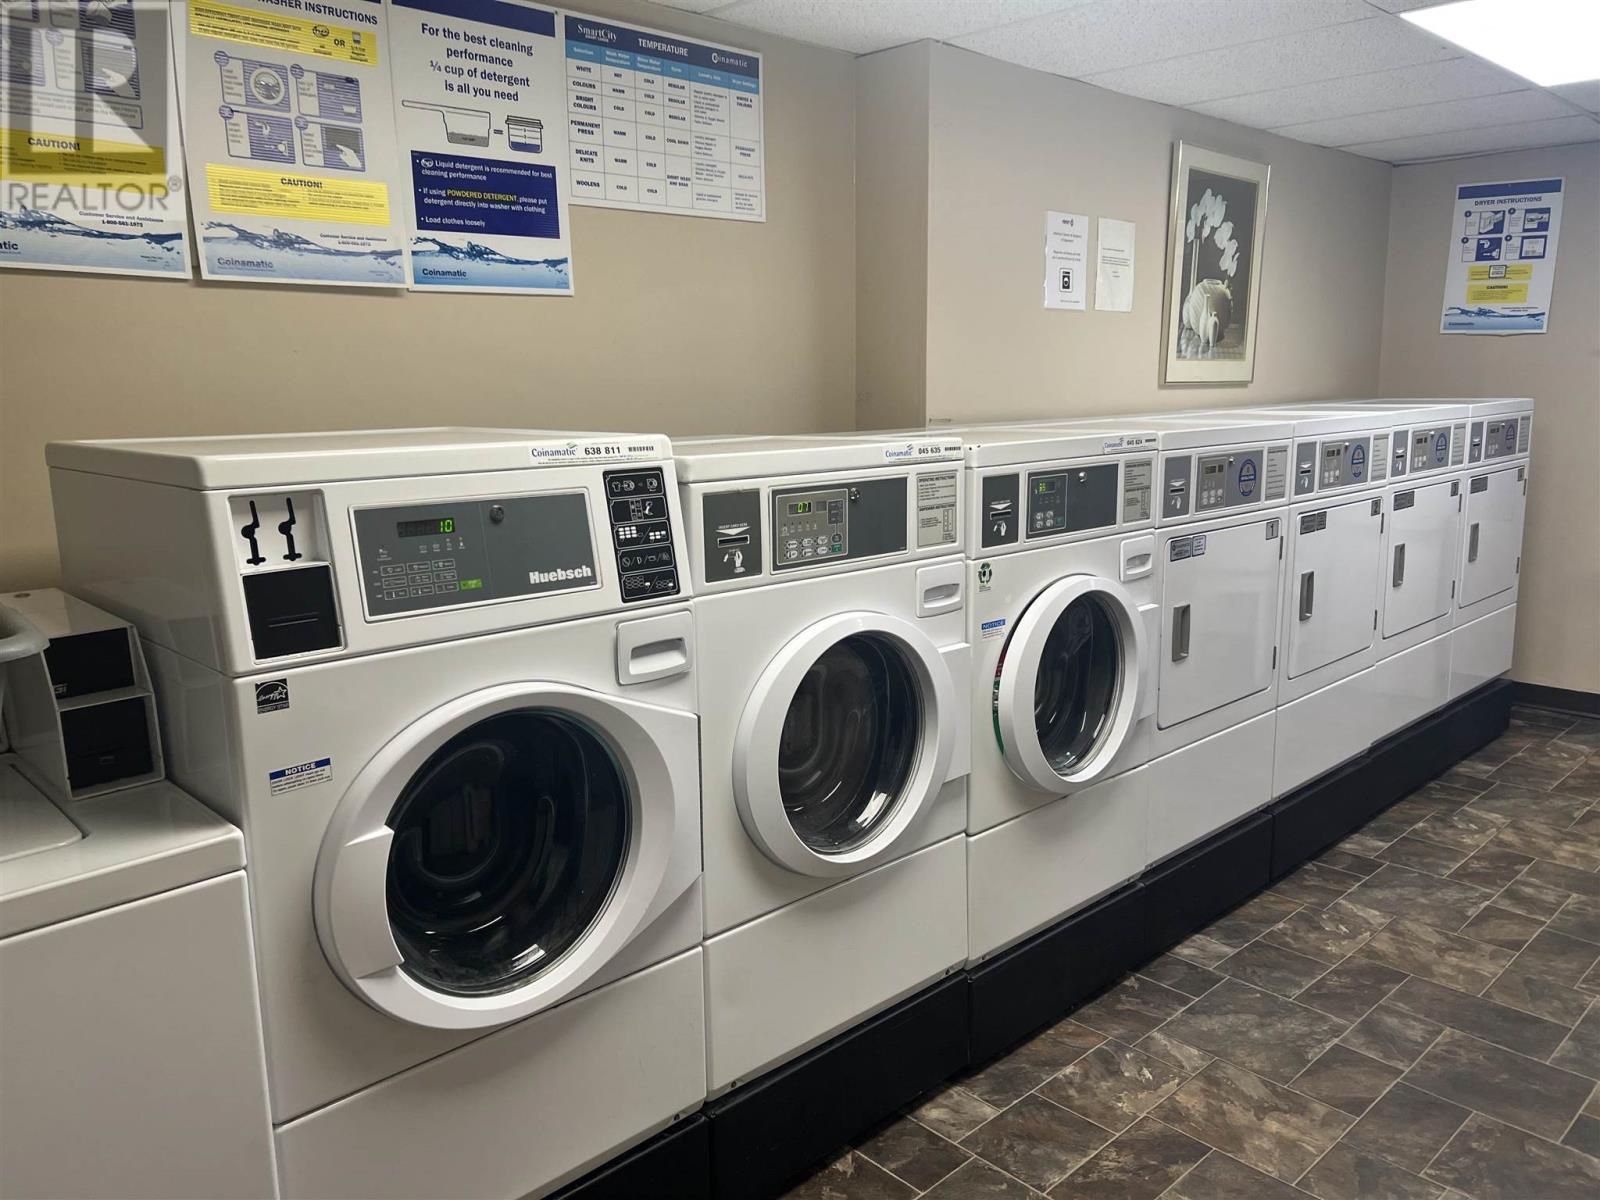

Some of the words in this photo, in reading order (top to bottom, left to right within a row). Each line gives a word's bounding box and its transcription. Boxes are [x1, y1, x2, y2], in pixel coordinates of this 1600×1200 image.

[258, 0, 301, 9] SHER
[305, 2, 378, 25] INSTRUCTIONS
[334, 38, 346, 48] OR
[421, 22, 440, 37] For
[442, 27, 461, 41] the
[463, 31, 487, 46] best
[489, 37, 534, 57] cleaning
[577, 23, 617, 43] SmartCity
[638, 38, 689, 57] TEMPERATURE
[446, 47, 513, 68] performance
[576, 65, 592, 73] WHITE
[444, 65, 464, 78] cup
[467, 66, 478, 79] of
[480, 69, 530, 87] detergent
[572, 80, 596, 89] COLOURS
[444, 80, 454, 92] is
[457, 82, 470, 94] all
[473, 86, 491, 98] you
[494, 89, 519, 102] need
[573, 102, 596, 111] COLOURS
[570, 119, 601, 129] PERMANENT
[577, 128, 594, 136] PRESS
[28, 137, 81, 151] CAUTION!
[575, 149, 598, 157] DELICATE
[422, 169, 448, 178] cleaning
[449, 172, 487, 181] performance
[435, 160, 454, 169] Liquid
[455, 163, 484, 172] detergent
[491, 167, 531, 177] recommended
[540, 171, 553, 179] best
[280, 177, 323, 189] CAUTION!
[576, 180, 600, 188] WOOLENS
[429, 189, 447, 197] using
[447, 189, 482, 199] POWDERED
[519, 196, 537, 204] please
[538, 197, 548, 205] put
[1497, 196, 1542, 205] INSTRUCTIONS
[424, 197, 453, 206] detergent
[454, 199, 476, 208] directly
[490, 203, 510, 211] washer
[524, 206, 546, 214] clothing
[425, 216, 441, 224] Load
[442, 217, 464, 226] clothes
[465, 219, 486, 227] loosely
[217, 257, 274, 269] Coinamatic
[422, 268, 467, 278] Coinamatic
[531, 447, 577, 458] Coinamatic
[584, 447, 601, 456] 638
[604, 446, 621, 455] 811
[885, 449, 913, 457] Coinamatic
[440, 519, 453, 533] 10
[529, 565, 591, 584] Huebsch
[983, 619, 1003, 629] NOTICE
[285, 762, 316, 776] NOTICE
